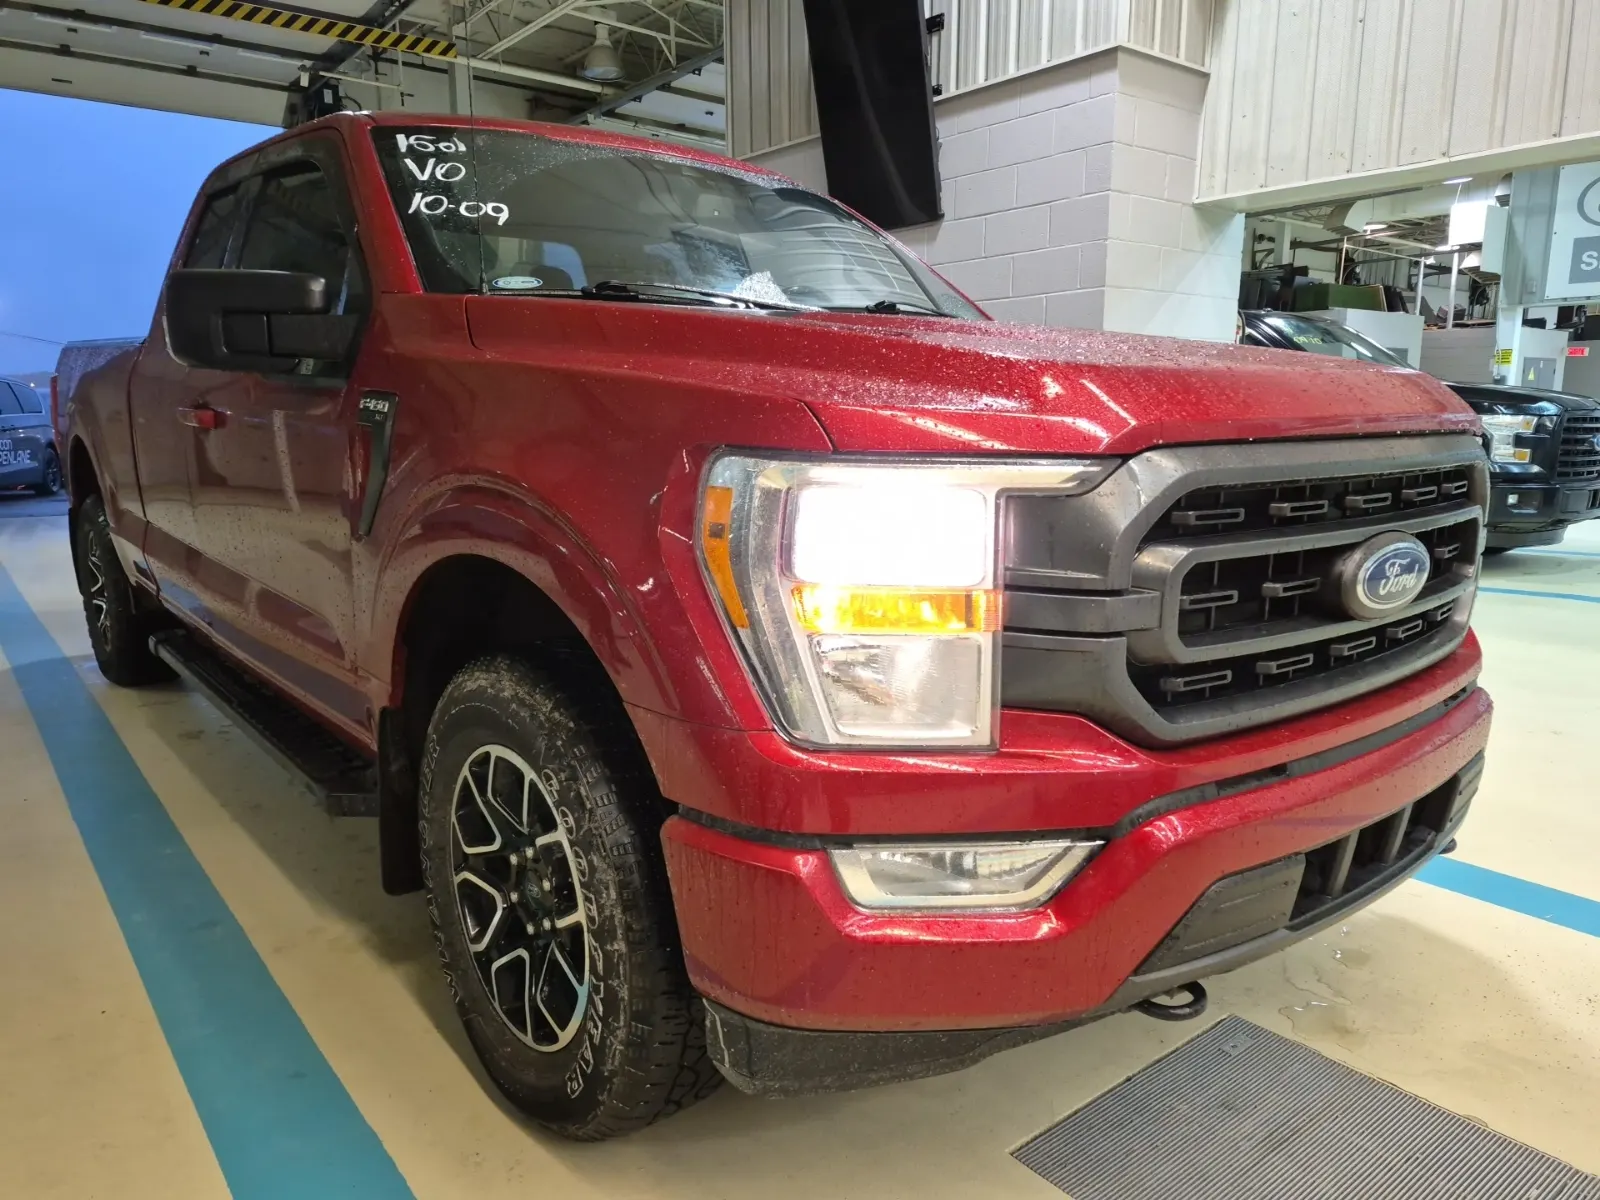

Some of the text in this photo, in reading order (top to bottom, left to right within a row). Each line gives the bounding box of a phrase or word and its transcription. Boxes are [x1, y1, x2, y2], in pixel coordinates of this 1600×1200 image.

[408, 192, 510, 226] 10-09
[1580, 250, 1600, 271] S
[1378, 557, 1419, 596] Ford
